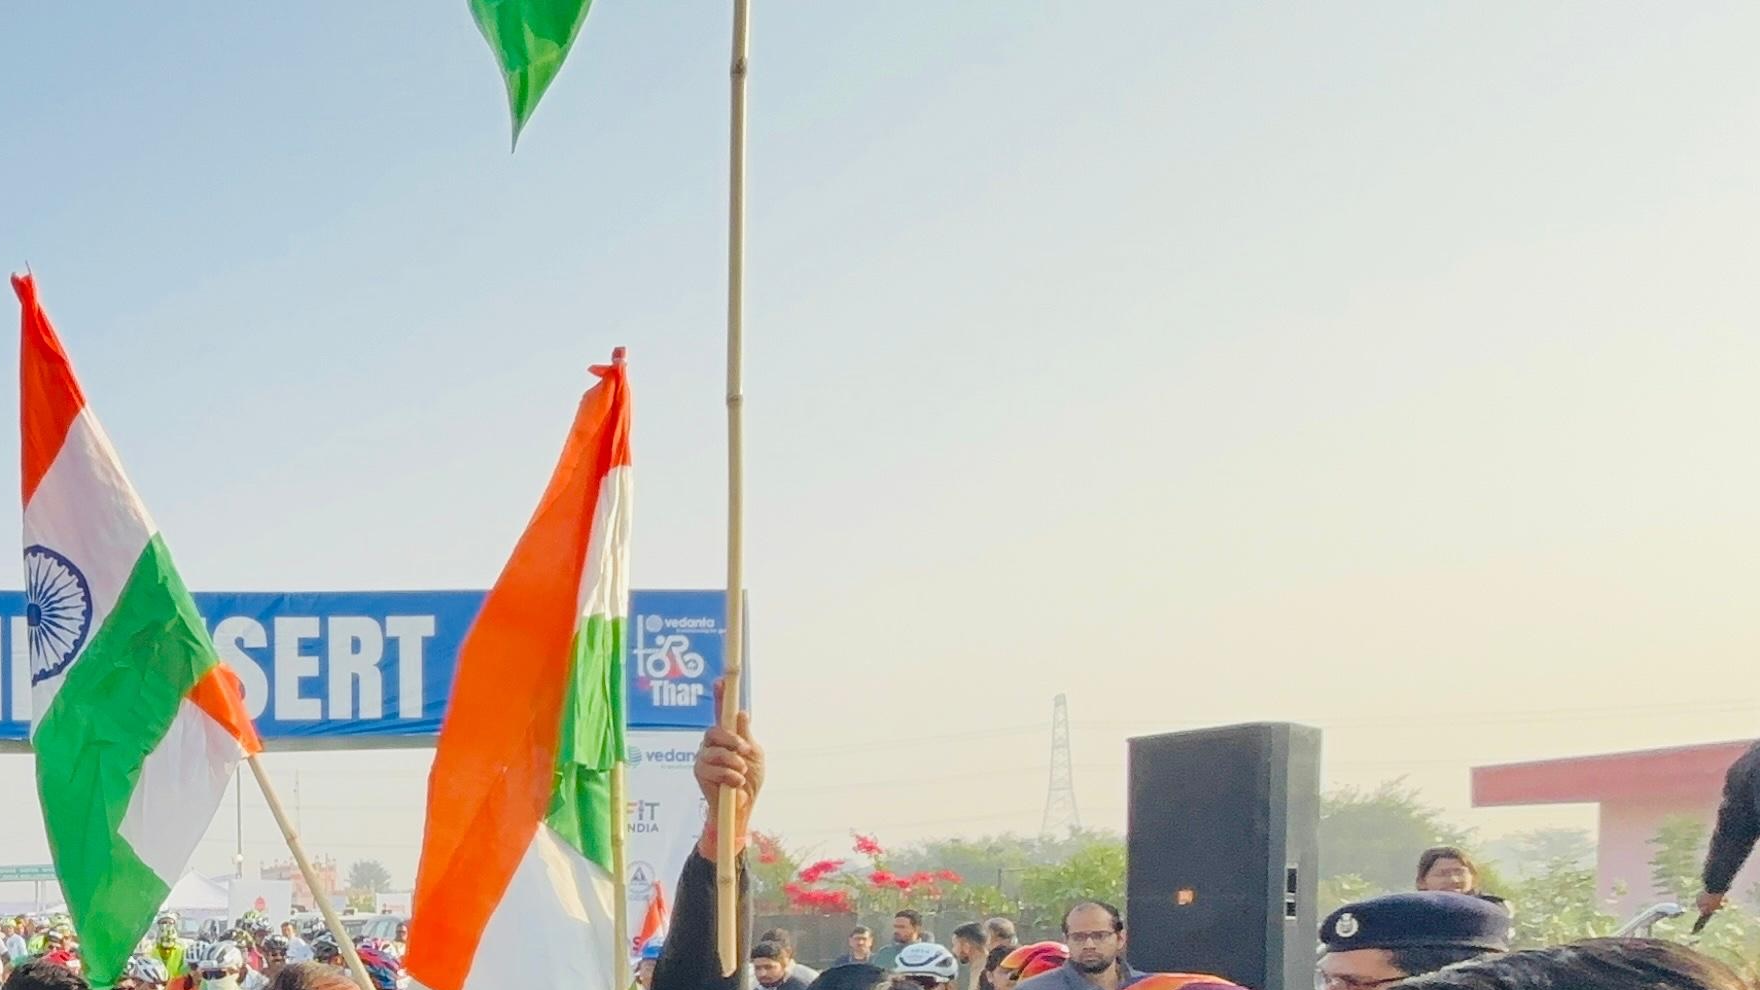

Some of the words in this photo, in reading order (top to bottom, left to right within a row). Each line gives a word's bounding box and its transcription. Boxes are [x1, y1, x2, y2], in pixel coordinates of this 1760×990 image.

[649, 680, 704, 707] Thar
[646, 748, 696, 762] vedan
[627, 823, 660, 833] NDIA
